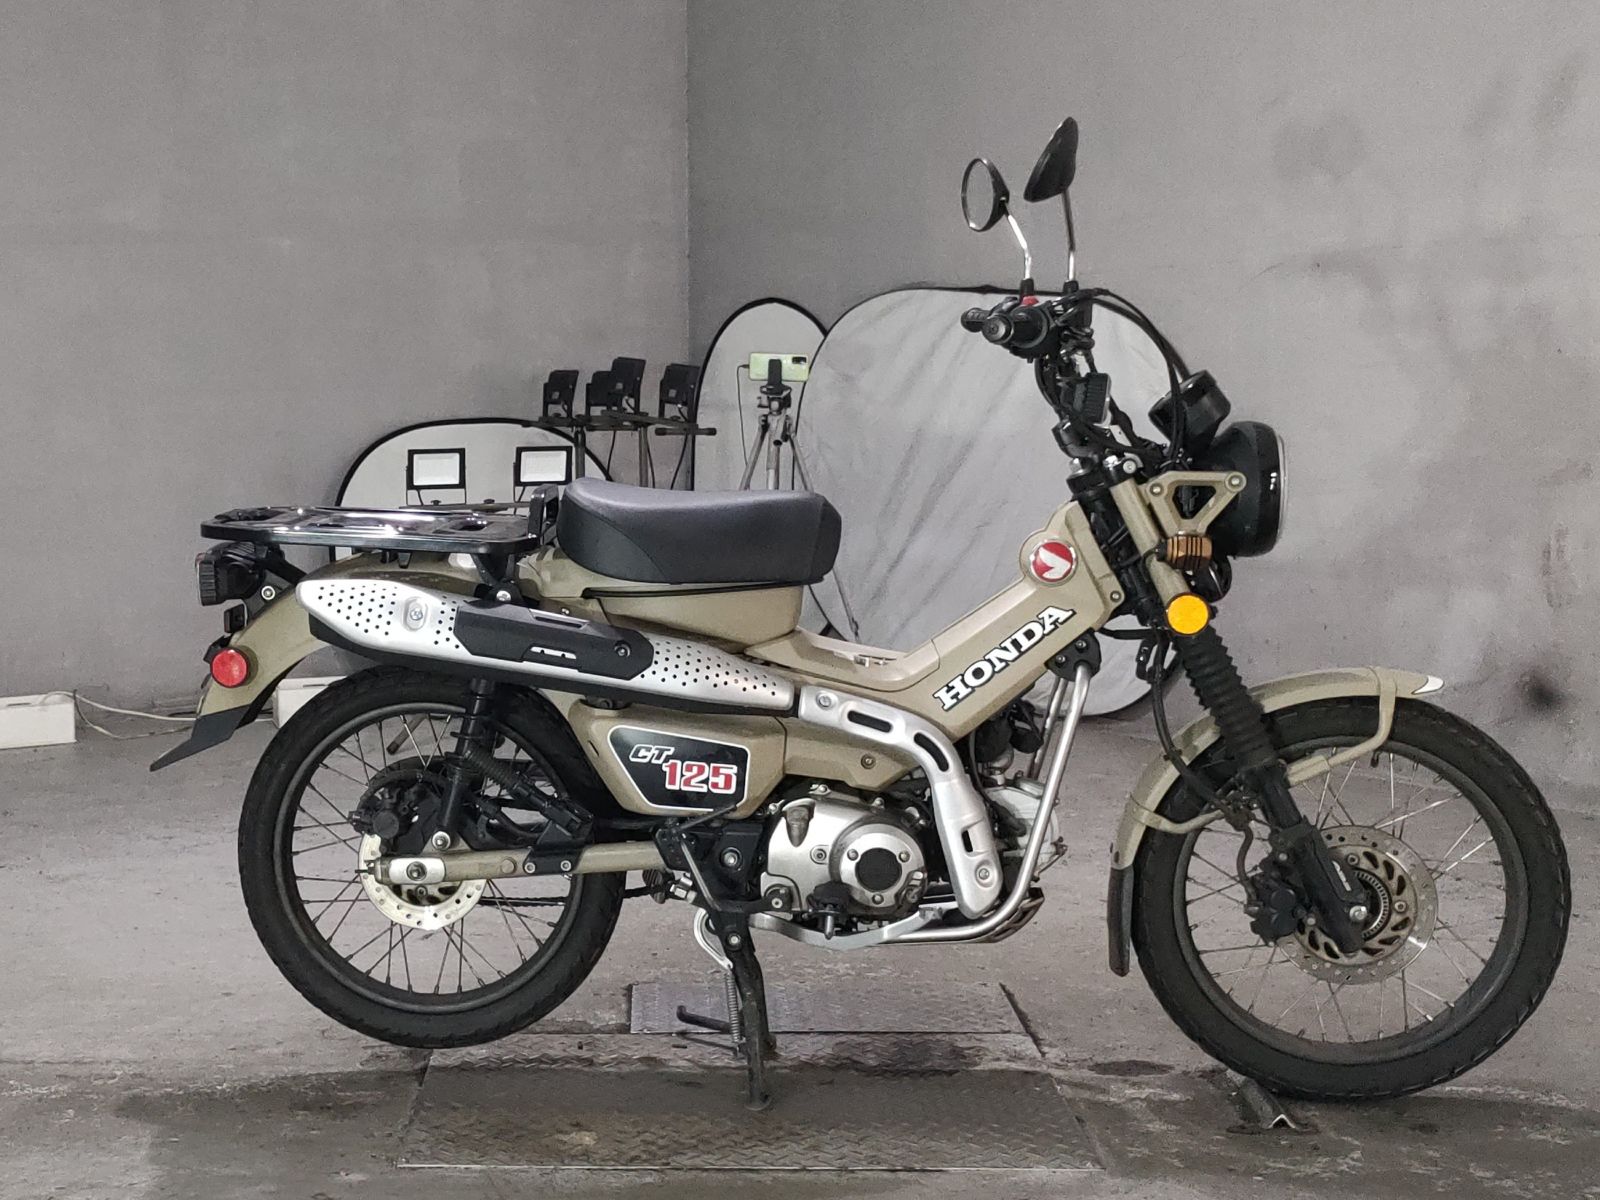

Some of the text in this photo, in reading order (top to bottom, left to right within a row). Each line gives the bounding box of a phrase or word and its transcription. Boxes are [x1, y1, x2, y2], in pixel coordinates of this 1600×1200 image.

[933, 606, 1077, 711] HONDA
[629, 744, 675, 764] CT
[662, 760, 737, 794] 125
